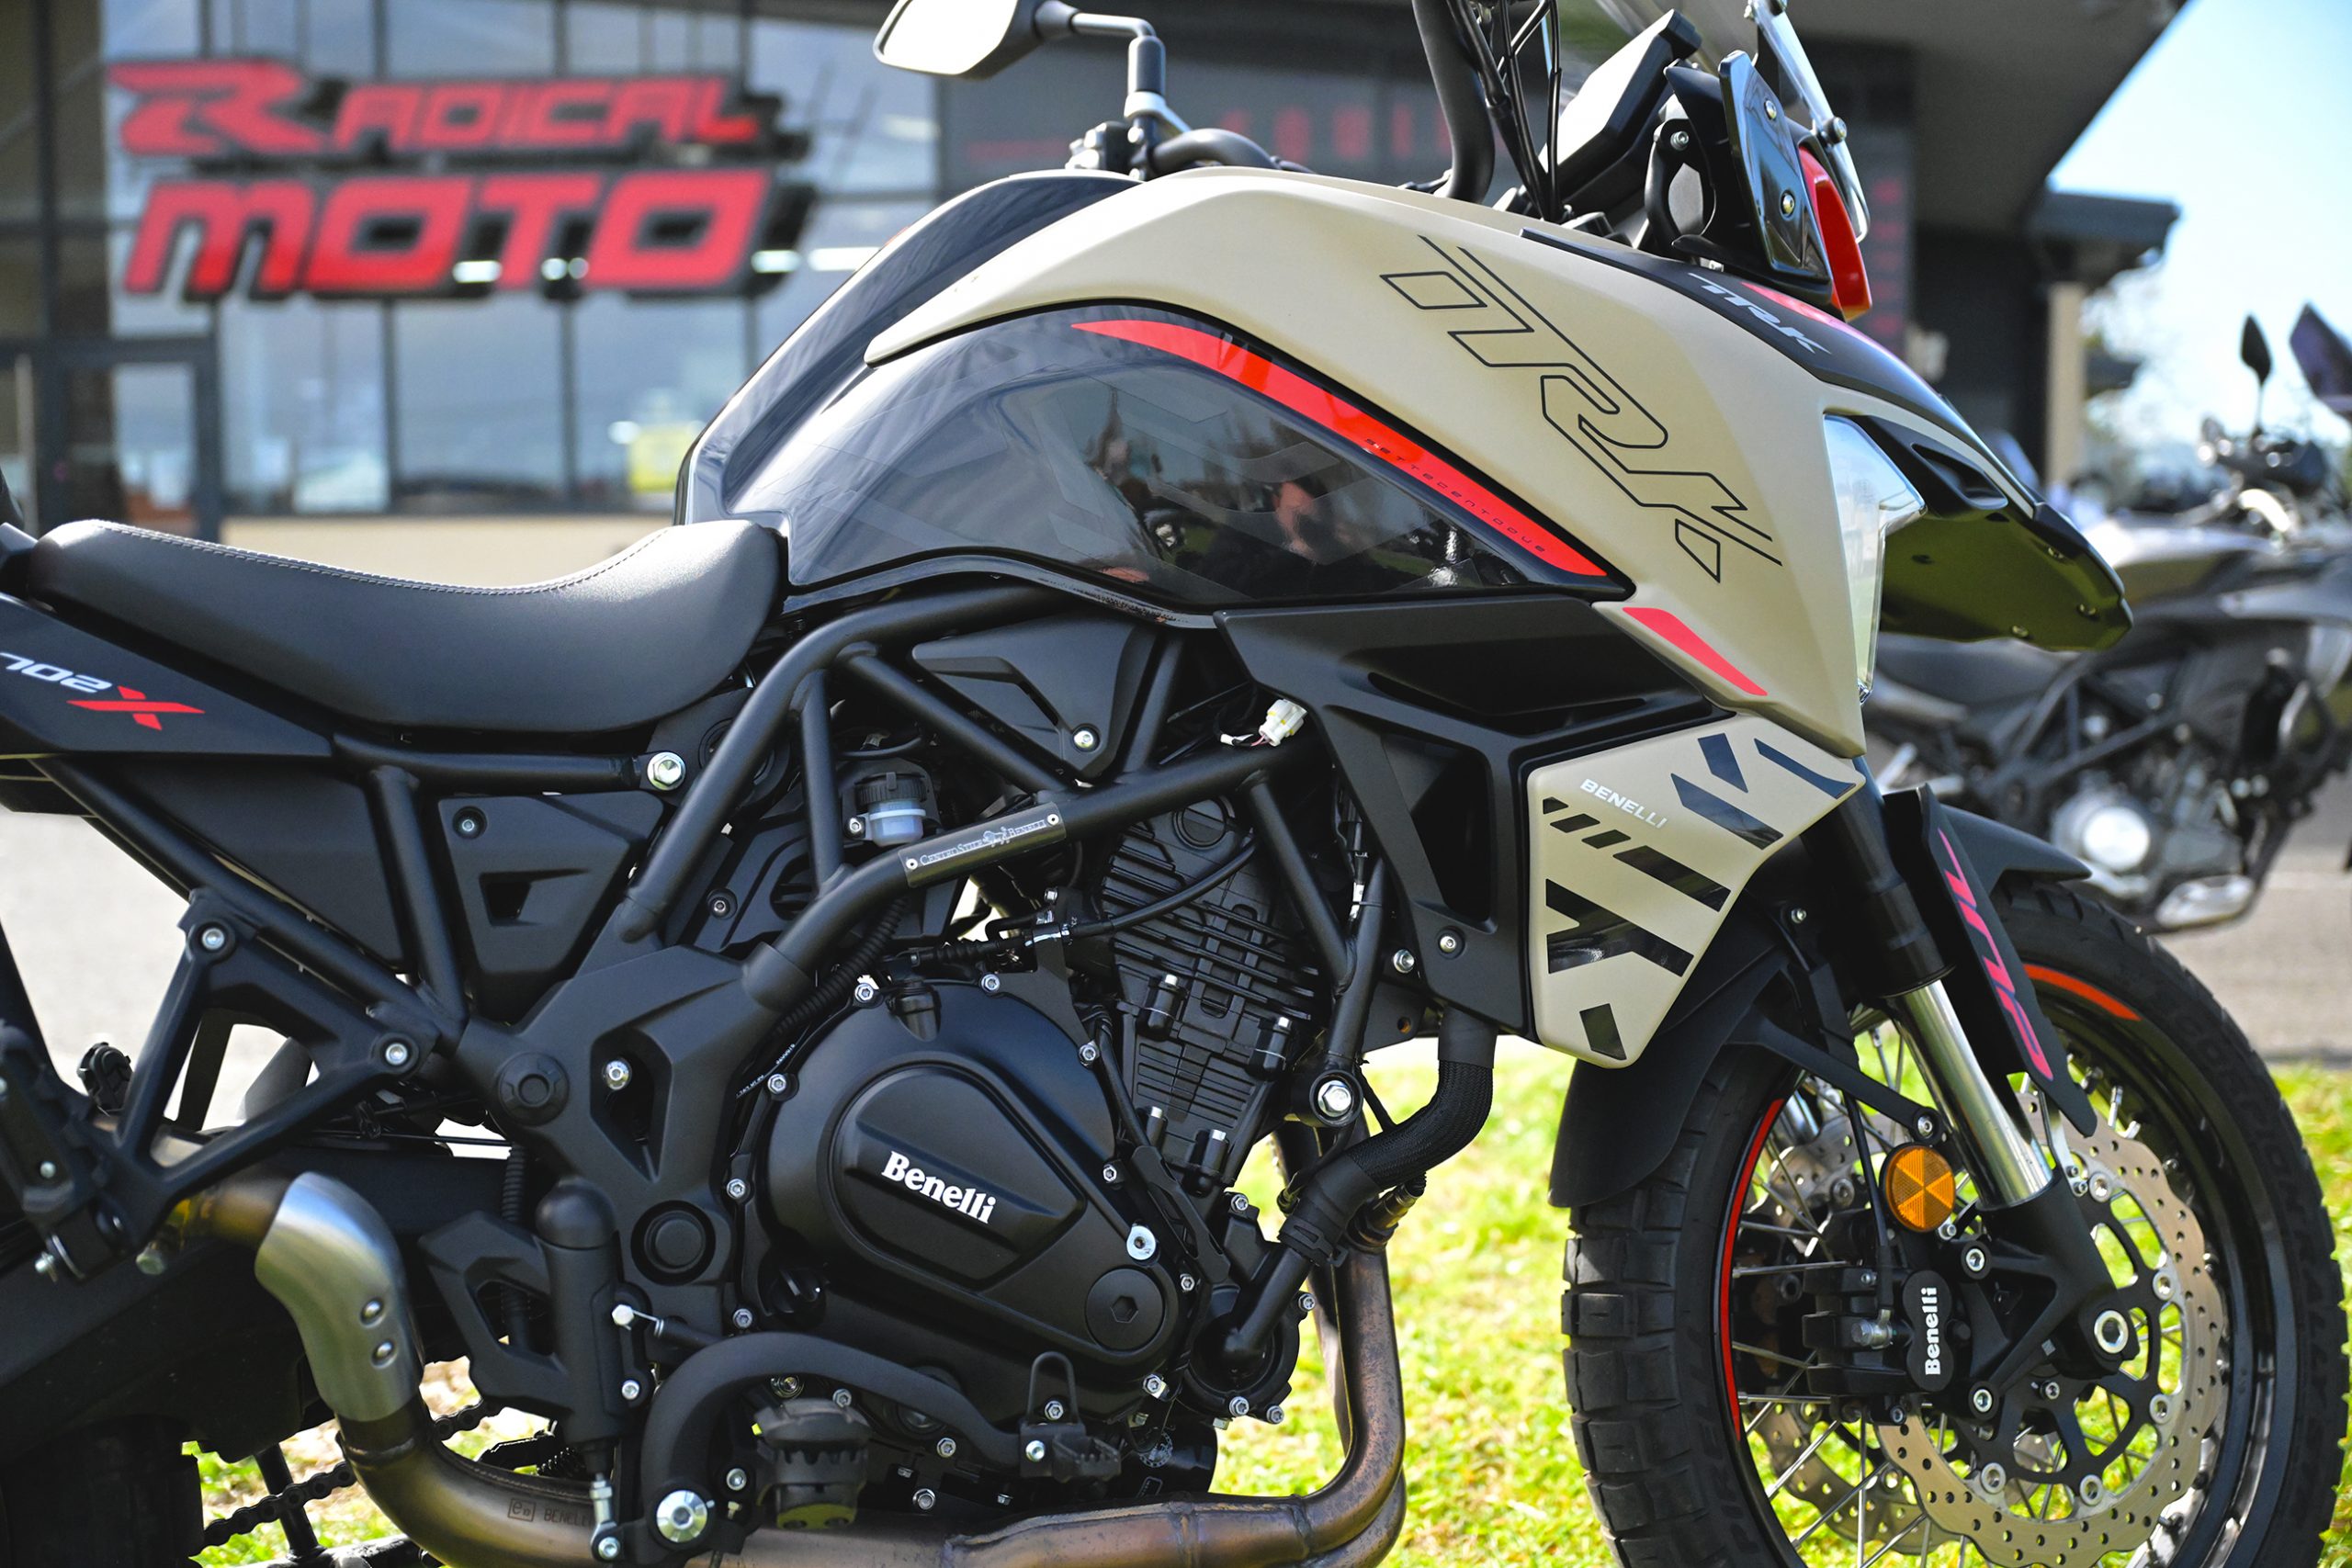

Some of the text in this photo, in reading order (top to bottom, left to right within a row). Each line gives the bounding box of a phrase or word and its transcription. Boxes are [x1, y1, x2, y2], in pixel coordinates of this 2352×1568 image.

[107, 59, 758, 154] RADICAL
[125, 173, 766, 290] MOTO
[1688, 273, 1832, 354] TRK
[1580, 779, 1668, 829] BENELLI
[881, 1151, 996, 1224] Benelli
[1921, 1288, 1941, 1375] Benelli
